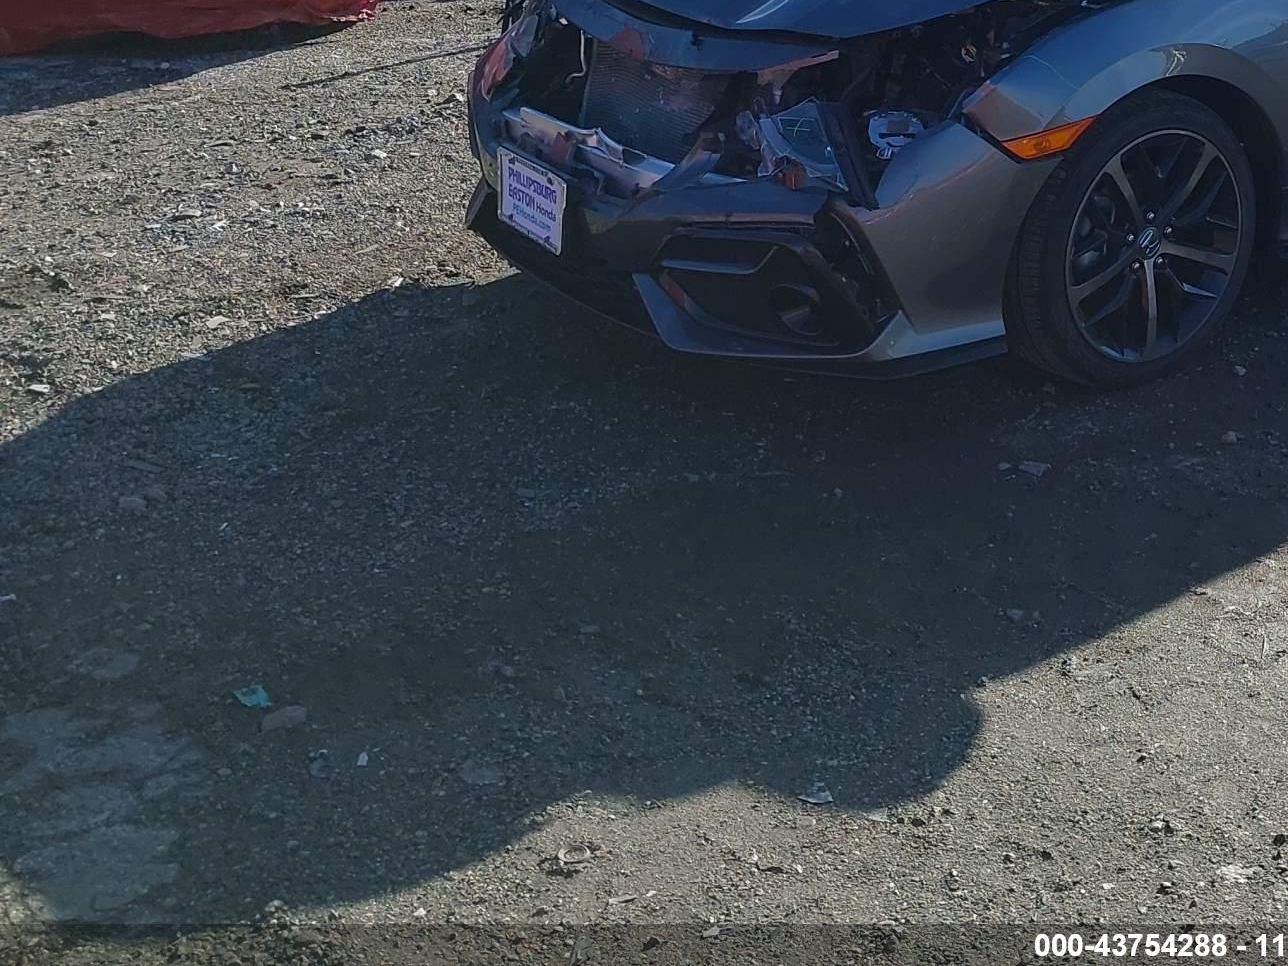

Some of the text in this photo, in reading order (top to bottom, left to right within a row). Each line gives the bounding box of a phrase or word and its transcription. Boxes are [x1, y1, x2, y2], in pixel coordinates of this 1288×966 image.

[508, 166, 557, 204] PHILLIPSBURG
[508, 184, 557, 223] EASTON Honda
